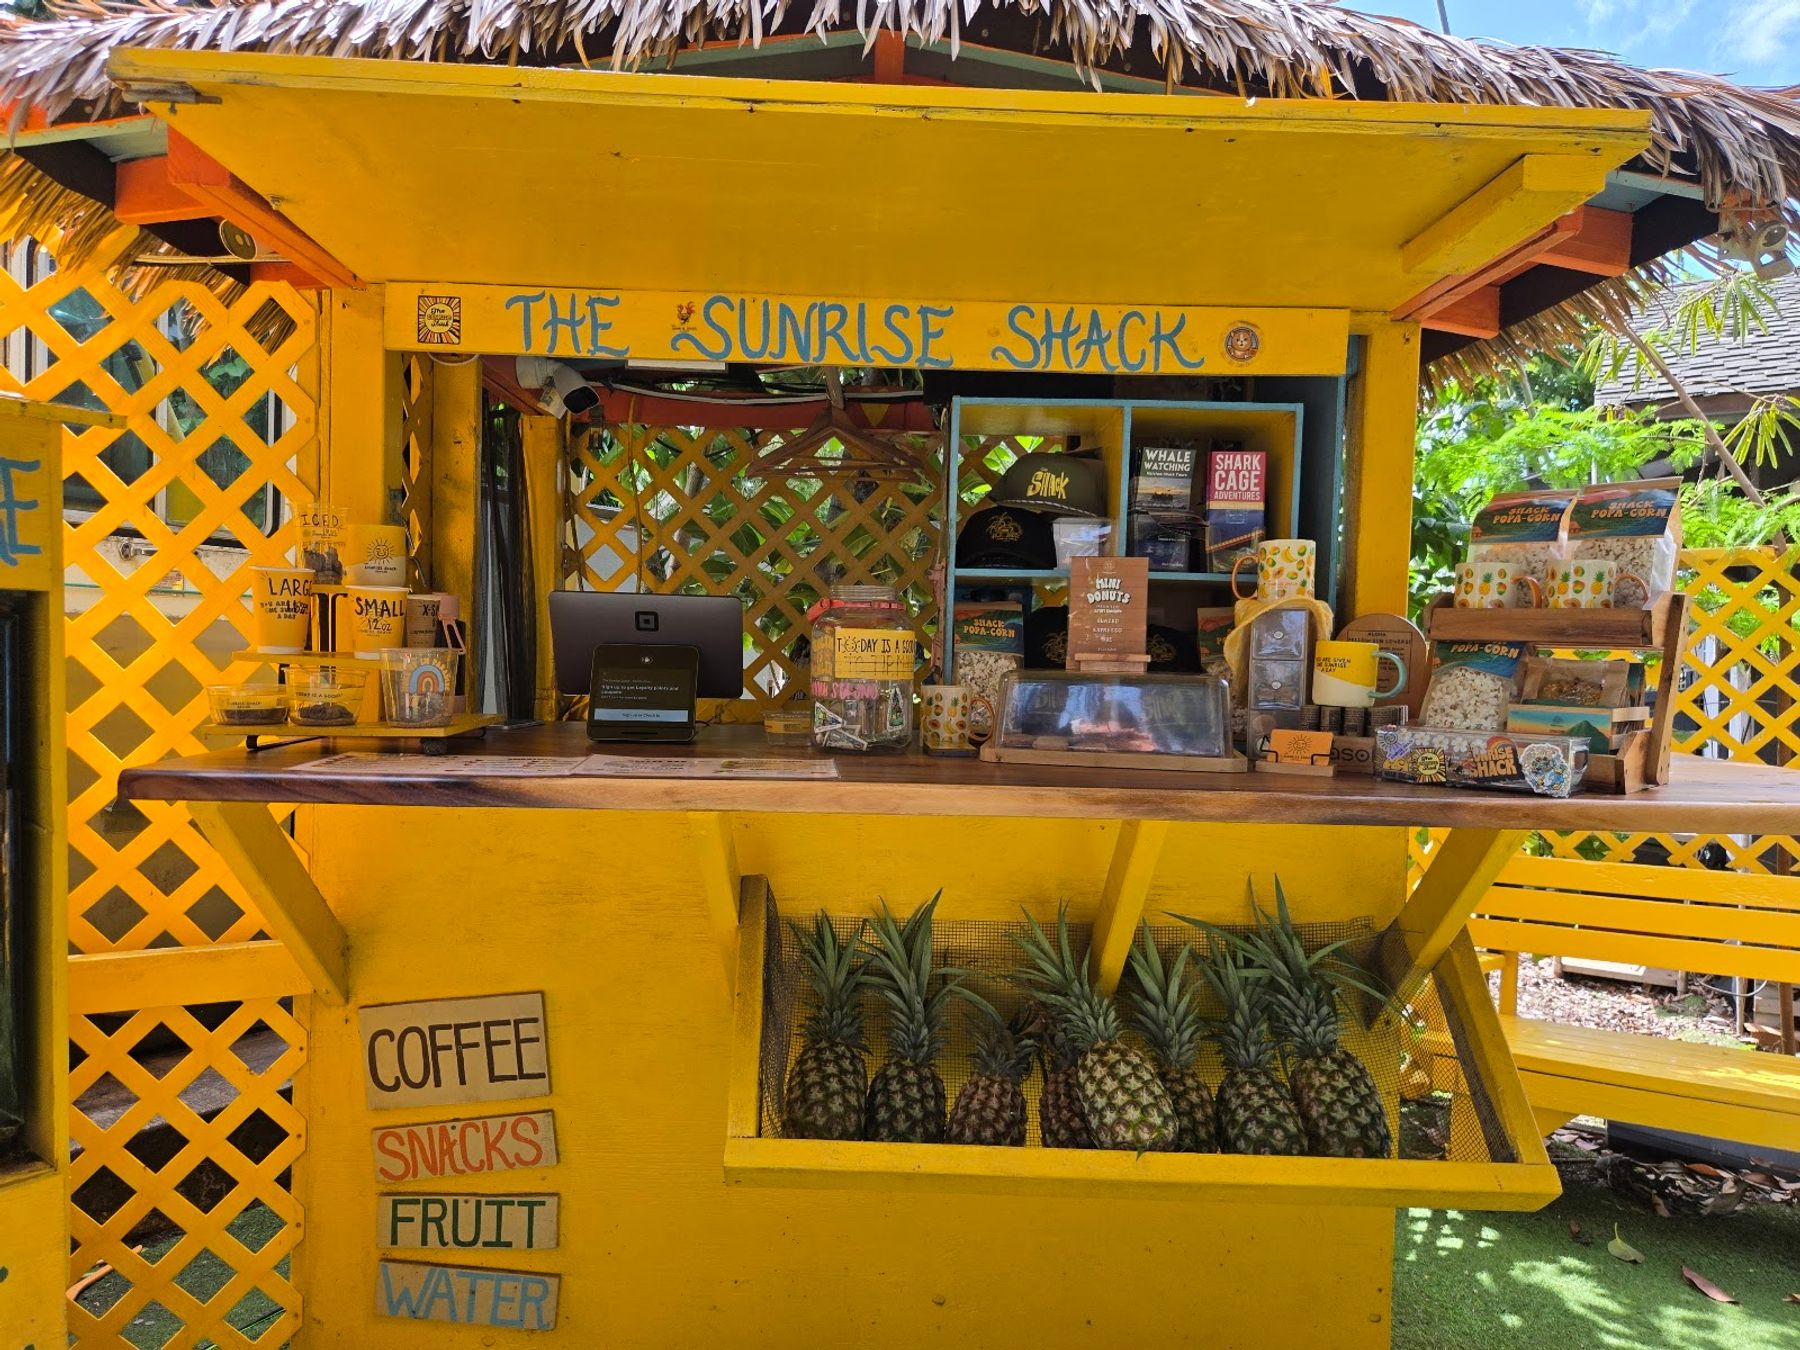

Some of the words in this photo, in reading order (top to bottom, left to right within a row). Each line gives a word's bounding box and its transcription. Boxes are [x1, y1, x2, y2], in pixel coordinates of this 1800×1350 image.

[505, 290, 629, 356] THE
[671, 295, 954, 368] SUNRISE
[991, 304, 1204, 373] SHACK
[1145, 449, 1192, 463] WHALE
[1215, 454, 1261, 470] SHARK
[1144, 461, 1191, 472] WATCHING
[1214, 470, 1260, 491] CAGE
[1213, 491, 1261, 500] ADVENTURES
[1508, 507, 1551, 515] SHACK
[1608, 501, 1654, 509] SHACK
[301, 512, 340, 527] ICED
[1492, 513, 1561, 524] POPA-CORN
[1591, 508, 1668, 519] POPA-CORN
[1096, 577, 1122, 590] MINI
[1086, 589, 1132, 605] DONUTS
[354, 596, 405, 618] SMALL
[973, 618, 1005, 628] SHACK
[963, 625, 1016, 638] POPA-CORN
[882, 638, 891, 653] IS
[894, 639, 900, 653] A
[1450, 643, 1520, 659] POPA-CORN
[1472, 746, 1514, 762] UNRISE
[1470, 758, 1518, 778] SHACK
[368, 1017, 546, 1092] COFFEE
[377, 1116, 544, 1181] SNACKS
[390, 1198, 546, 1248] FRUIT
[380, 1263, 550, 1329] WATER
